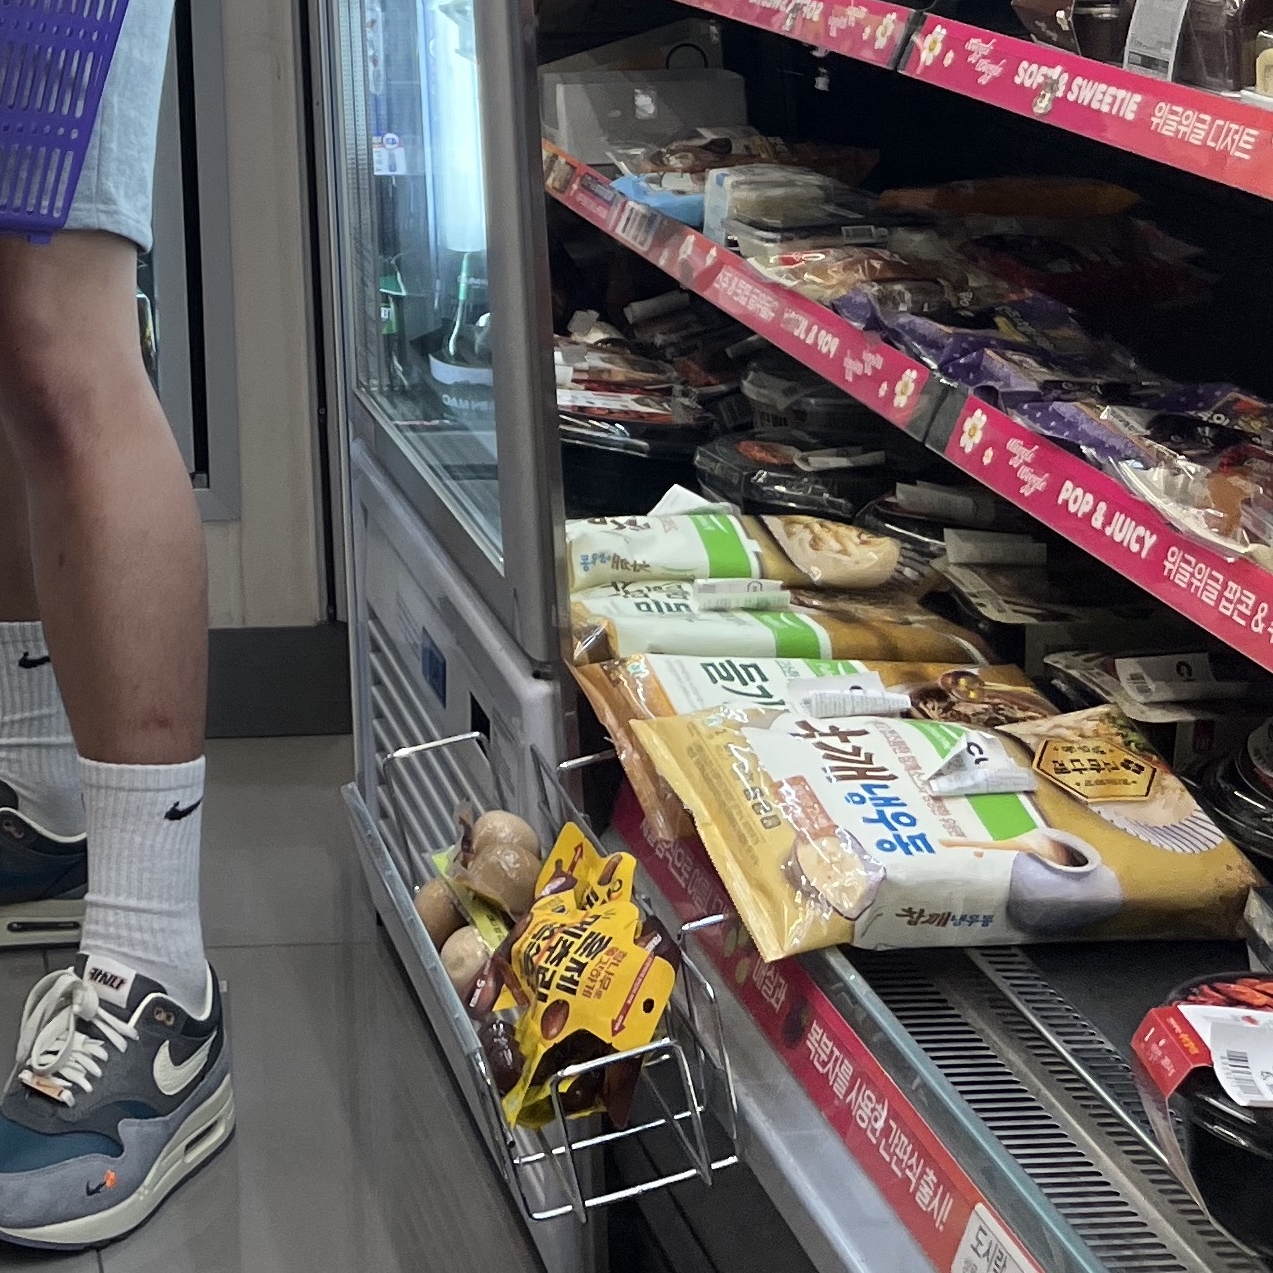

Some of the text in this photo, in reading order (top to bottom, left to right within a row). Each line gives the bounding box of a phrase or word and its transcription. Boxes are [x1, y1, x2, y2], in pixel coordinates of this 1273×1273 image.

[1066, 76, 1142, 122] SWEETIE
[1150, 100, 1212, 148] 위글위글
[1206, 119, 1260, 160] 디저트
[1057, 479, 1270, 637] POP & JUICY 위글위글 팝콘 &
[843, 781, 937, 858] 냉우동
